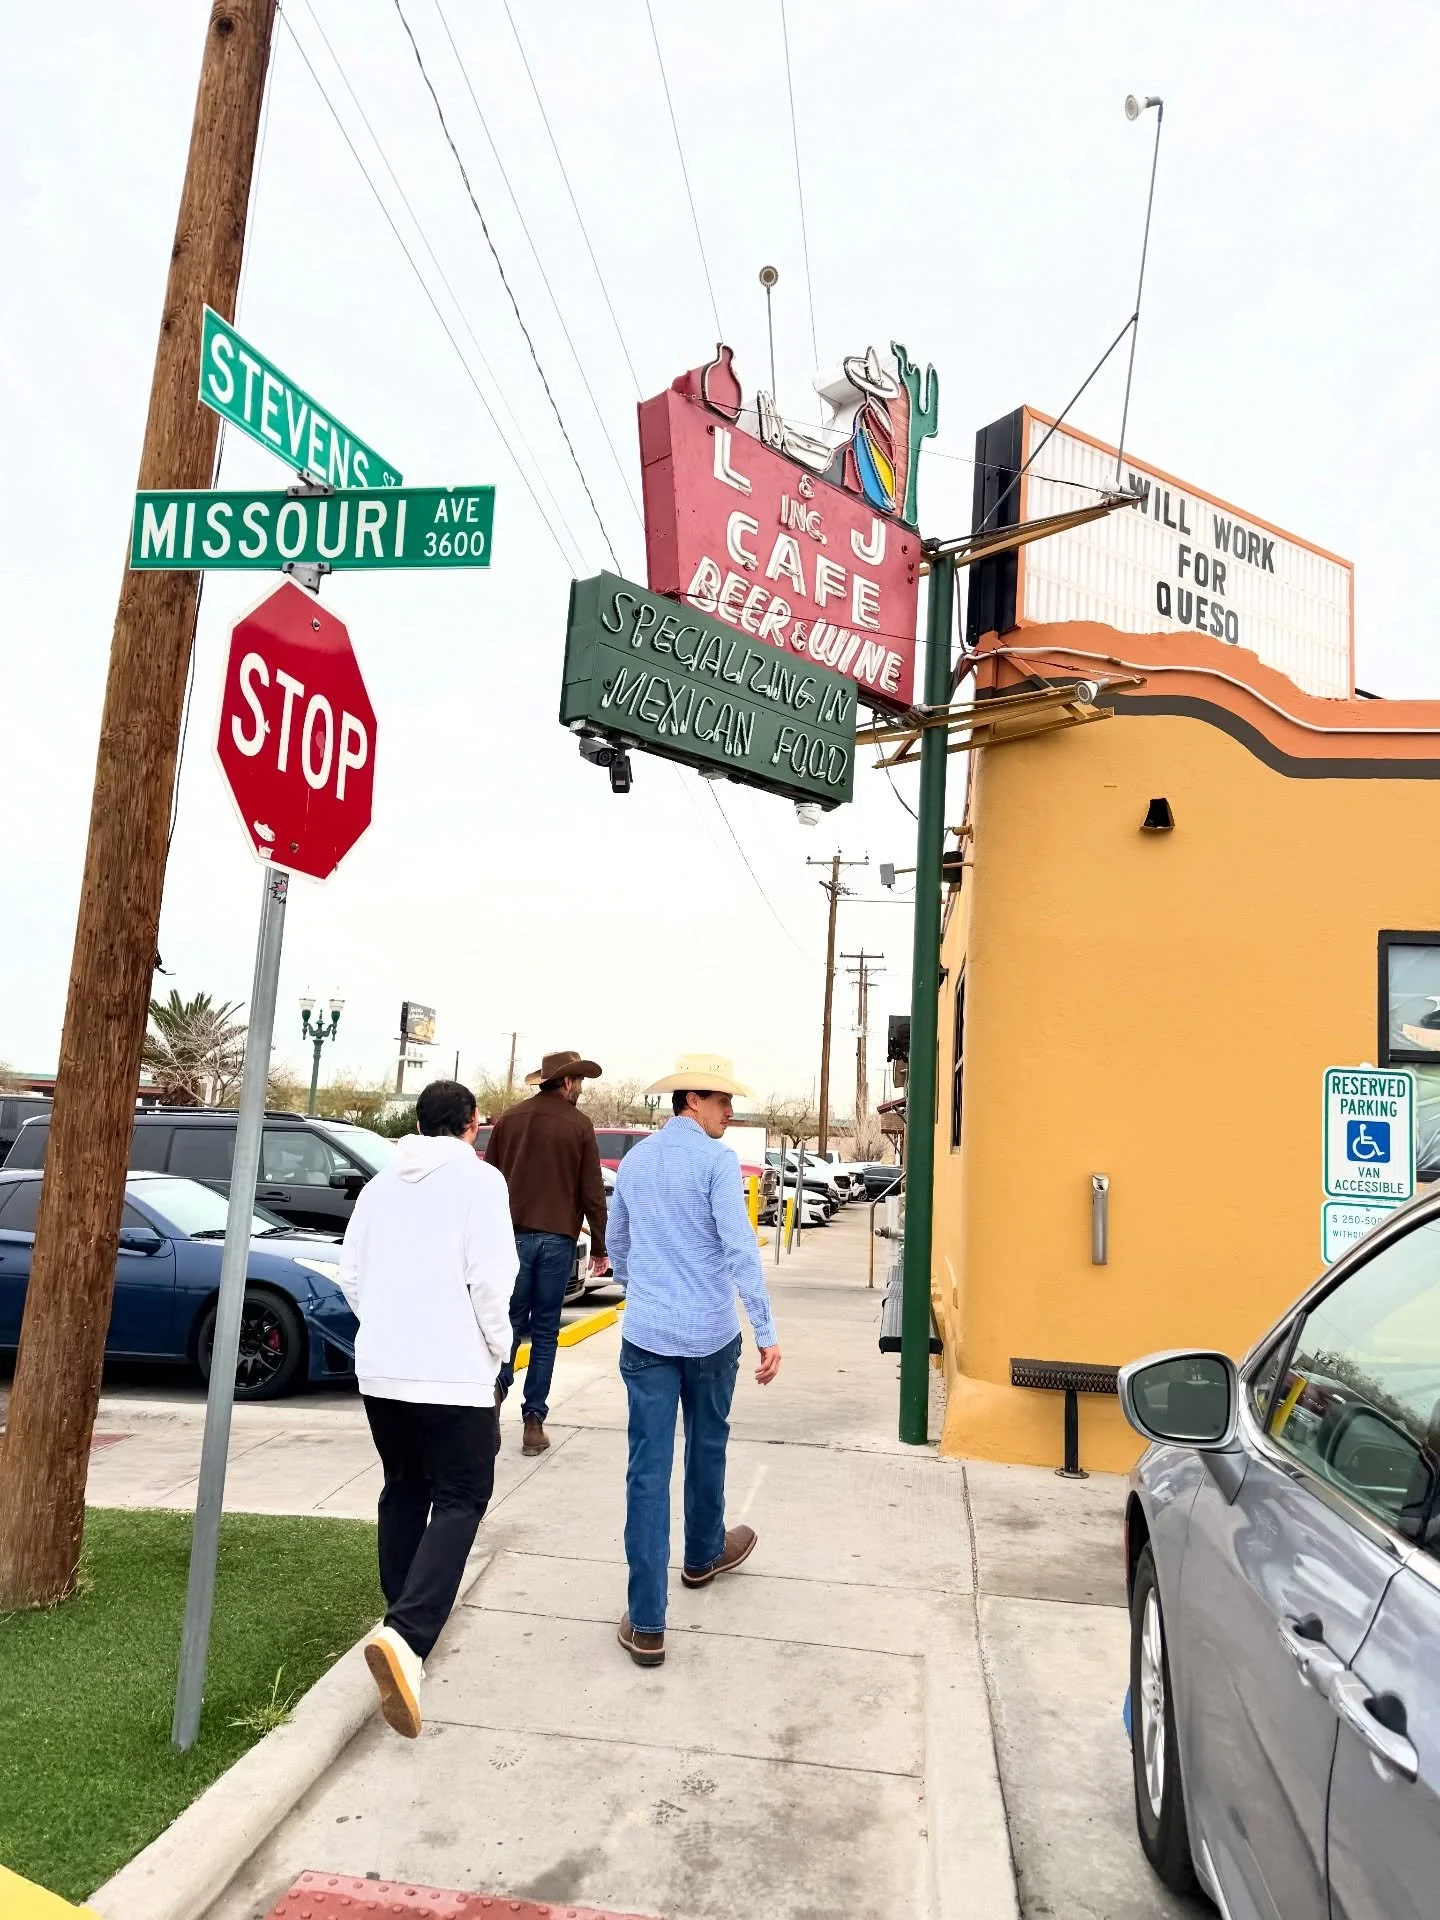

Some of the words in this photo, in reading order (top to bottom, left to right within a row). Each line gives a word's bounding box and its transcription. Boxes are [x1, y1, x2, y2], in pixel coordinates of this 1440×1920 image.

[208, 333, 369, 487] STEVENS
[140, 500, 407, 559] MISSOURI
[434, 497, 480, 523] AVE
[713, 426, 752, 496] L
[850, 517, 886, 566] J
[1128, 472, 1191, 536] WILL
[1213, 513, 1275, 574] WORK
[423, 531, 484, 557] 3600
[726, 510, 881, 631] CAFE
[1178, 543, 1227, 596] FOR
[602, 592, 816, 709] SPECIALIZING
[817, 683, 852, 724] IN
[687, 556, 792, 648] BEER
[808, 618, 904, 695] WINE
[232, 652, 368, 801] STOP
[601, 667, 755, 757] MEXICAN
[772, 726, 847, 784] FOOD
[1332, 1076, 1406, 1097] RESERVED
[1340, 1098, 1397, 1117] PARKING
[1335, 1180, 1404, 1194] ACCESSIBLE
[1358, 1167, 1380, 1179] VAN
[1332, 1230, 1364, 1239] WITHOU
